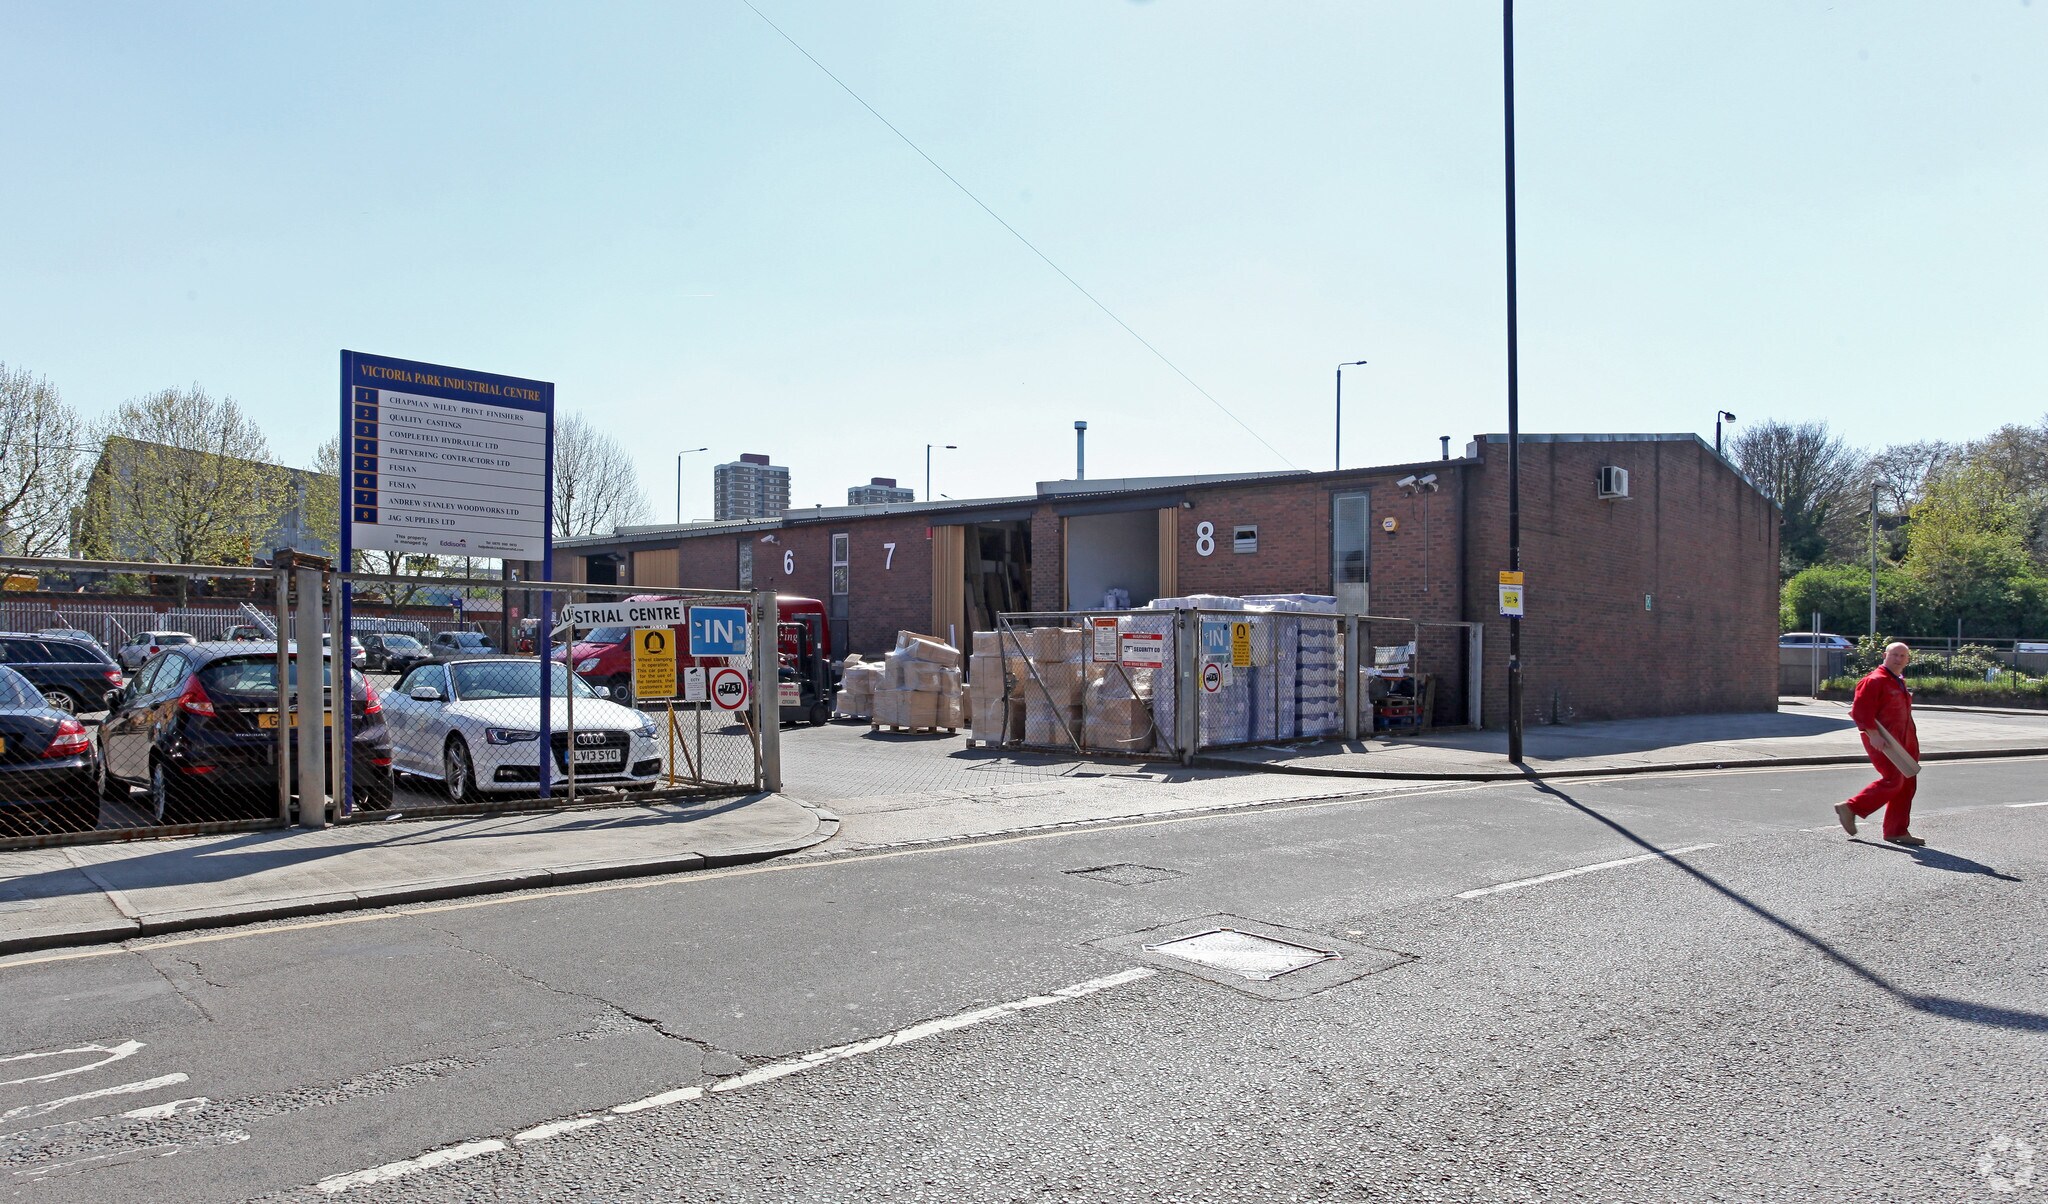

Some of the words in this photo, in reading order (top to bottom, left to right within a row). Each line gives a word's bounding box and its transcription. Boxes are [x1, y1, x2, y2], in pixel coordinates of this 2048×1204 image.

[361, 364, 412, 382] VICTORIA
[415, 372, 442, 387] PARK
[443, 377, 501, 396] INDUSTRIAL
[503, 386, 540, 401] CENTRE
[365, 392, 369, 400] 1
[389, 397, 429, 408] CHAPMAN
[433, 403, 457, 413] WILEY
[461, 407, 484, 416] PRINT
[486, 411, 524, 421] FINISHERS
[364, 409, 369, 417] 2
[389, 414, 423, 424] QUALITY
[426, 419, 462, 429] CASTINGS
[364, 426, 369, 434] 3
[389, 430, 440, 442] COMPLETELY
[441, 437, 484, 448] HYDRAULIC
[485, 442, 499, 450] LTD
[363, 443, 369, 451] 4
[390, 447, 438, 459] PARTNERING
[441, 453, 495, 465] CONTRACTORS
[497, 459, 511, 467] LTD
[363, 460, 369, 468] 5
[389, 464, 417, 473] FUSIAN
[363, 477, 369, 485] 6
[389, 481, 416, 489] FUSIAN
[363, 494, 369, 502] 7
[388, 498, 421, 507] ANDREW
[423, 501, 456, 510] STANLEY
[457, 504, 505, 514] WOODWORKS
[506, 508, 519, 516] LTD
[363, 511, 369, 519] 8
[388, 514, 402, 522] JAG
[405, 515, 440, 525] SUPPLIES
[441, 518, 455, 526] LTD
[1195, 521, 1215, 557] 8
[783, 550, 795, 575] 6
[883, 542, 896, 570] 7
[629, 606, 681, 622] CENTRE
[705, 619, 733, 644] IN
[1209, 629, 1224, 647] IN
[574, 750, 597, 761] LV13
[598, 750, 617, 760] SYO
